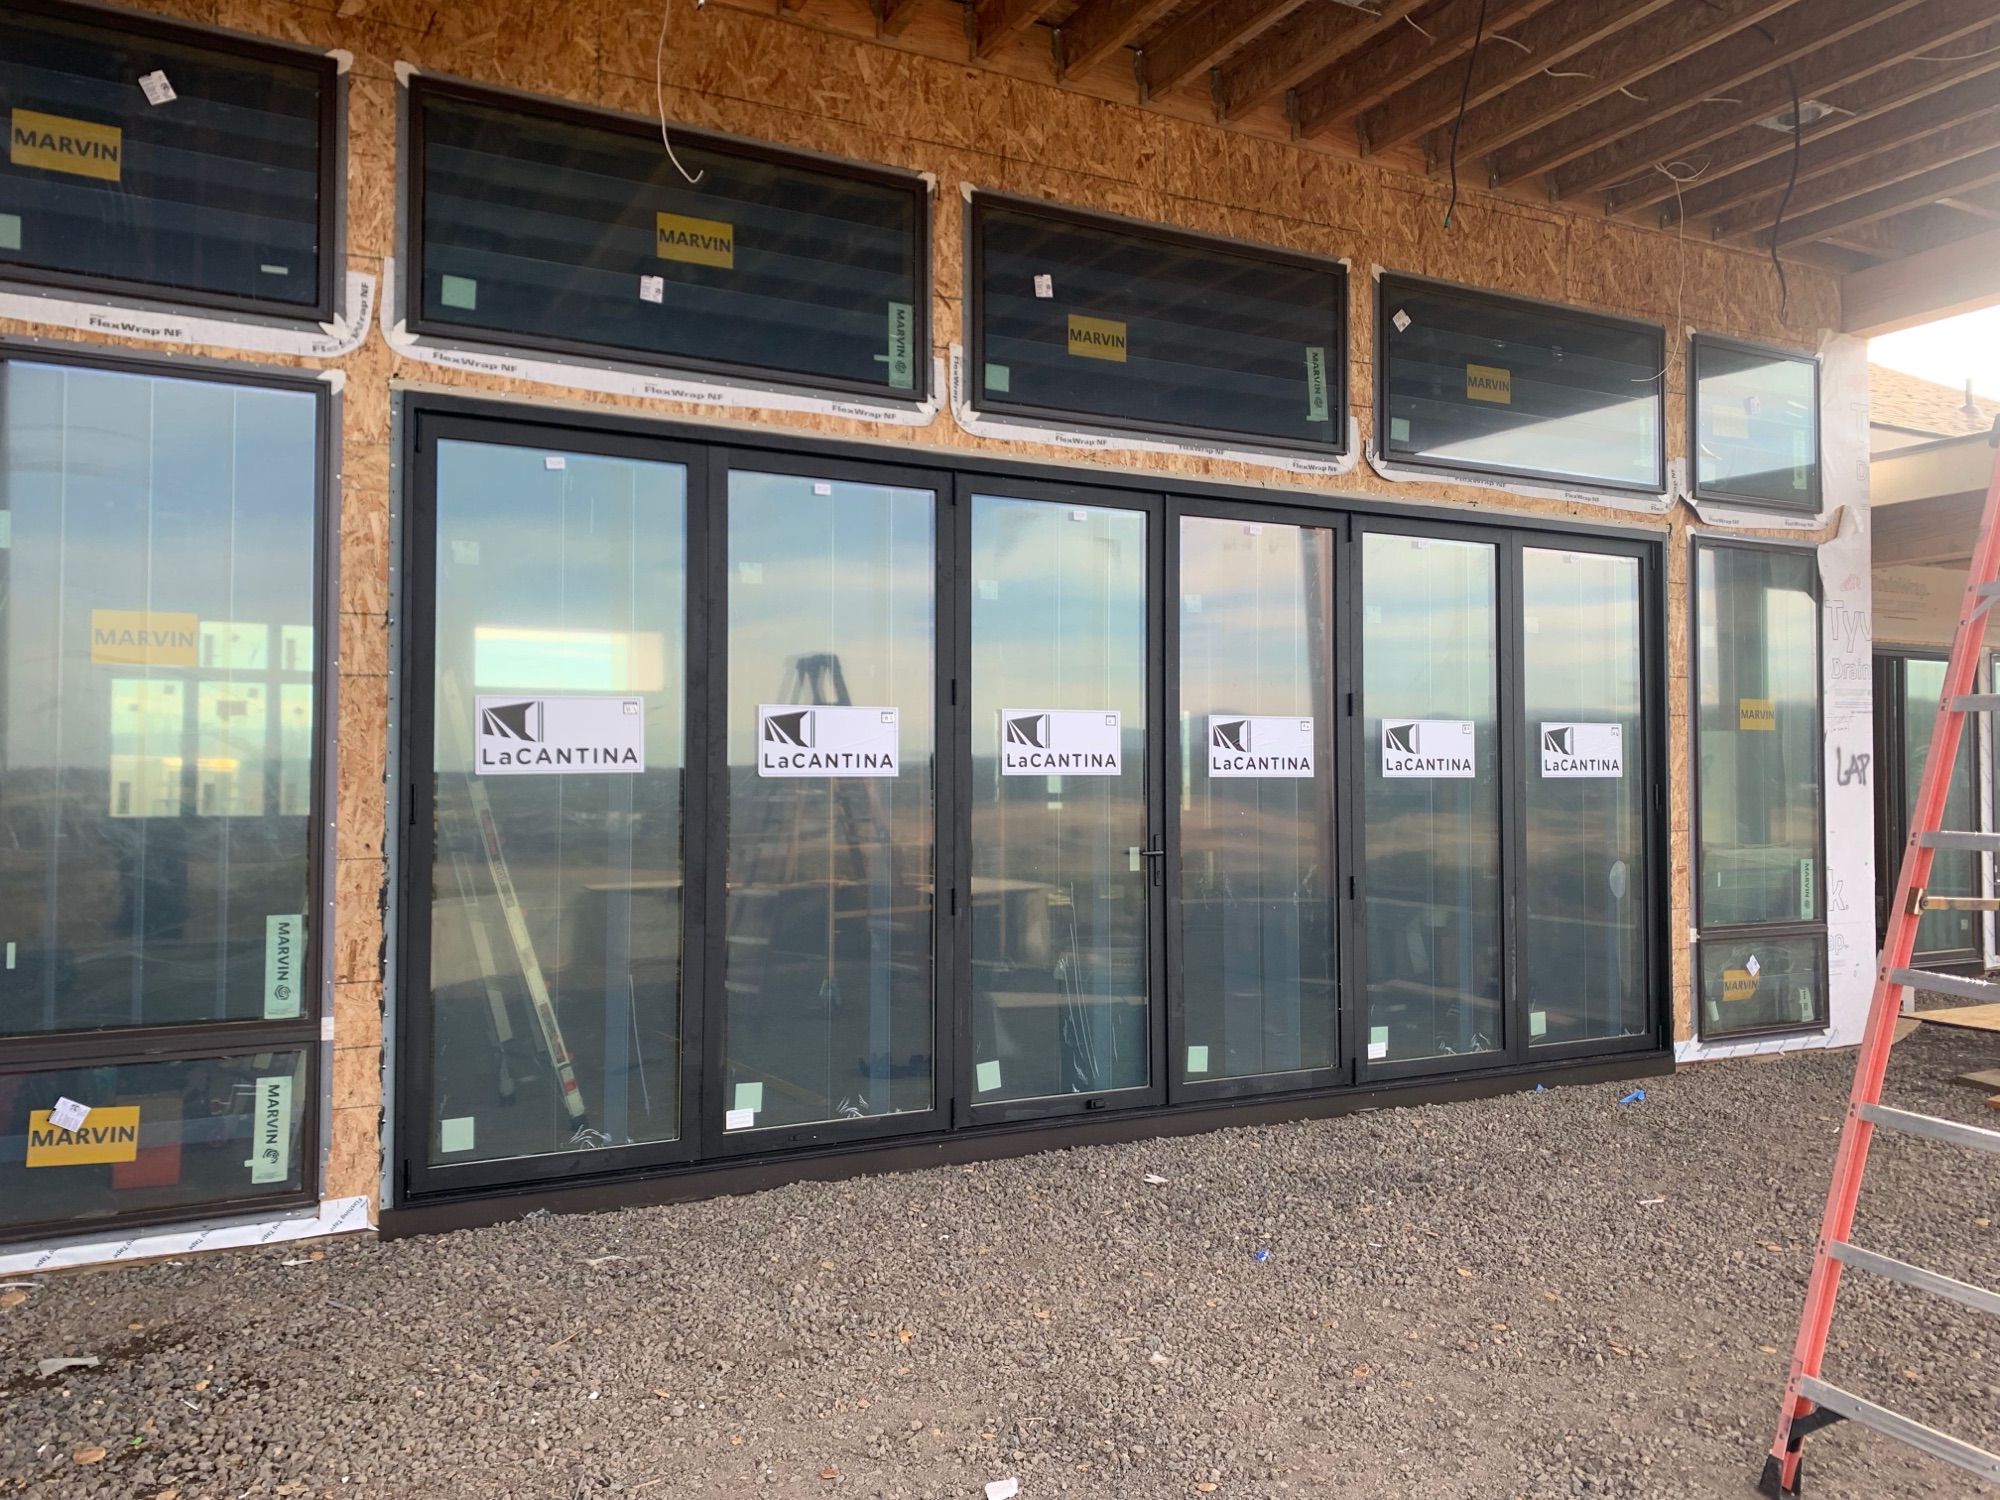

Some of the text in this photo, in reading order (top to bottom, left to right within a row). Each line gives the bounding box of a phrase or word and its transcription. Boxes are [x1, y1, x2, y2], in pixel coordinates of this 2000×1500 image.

[14, 128, 118, 162] MARVIN
[659, 228, 731, 253] MARVIN
[89, 317, 183, 337] FlexWrap NF
[896, 309, 906, 358] MARVIN
[1070, 328, 1125, 349] MARVIN
[432, 351, 518, 373] FlexWrap NF
[1312, 352, 1321, 394] MARVIN
[1468, 376, 1510, 392] MARVIN
[644, 386, 724, 401] FlexWrap NF
[831, 404, 897, 420] FlexWrap NF
[1055, 435, 1095, 447] FlexWrap
[1292, 462, 1327, 472] FlexWrap
[1565, 492, 1591, 502] FlexWrap
[94, 628, 194, 648] MARVIN
[1741, 709, 1774, 720] MARVIN
[483, 747, 639, 765] LaCANTINA
[763, 752, 894, 769] LaCANTINA
[1006, 753, 1117, 768] LaCANTINA
[1212, 756, 1310, 771] LaCANTINA
[1385, 758, 1472, 772] LaCANTINA
[1544, 759, 1620, 772] LaCANTINA
[1836, 746, 1870, 786] LAP
[277, 922, 290, 981] MARVIN
[1724, 980, 1760, 991] MARVIN
[266, 1084, 280, 1144] MARVIN
[31, 1126, 136, 1147] MARVIN
[329, 1220, 343, 1232] Tape
[188, 1238, 203, 1250] Tape
[261, 1230, 275, 1242] Tape
[112, 1245, 128, 1259] Tape
[34, 1254, 51, 1268] Tape
